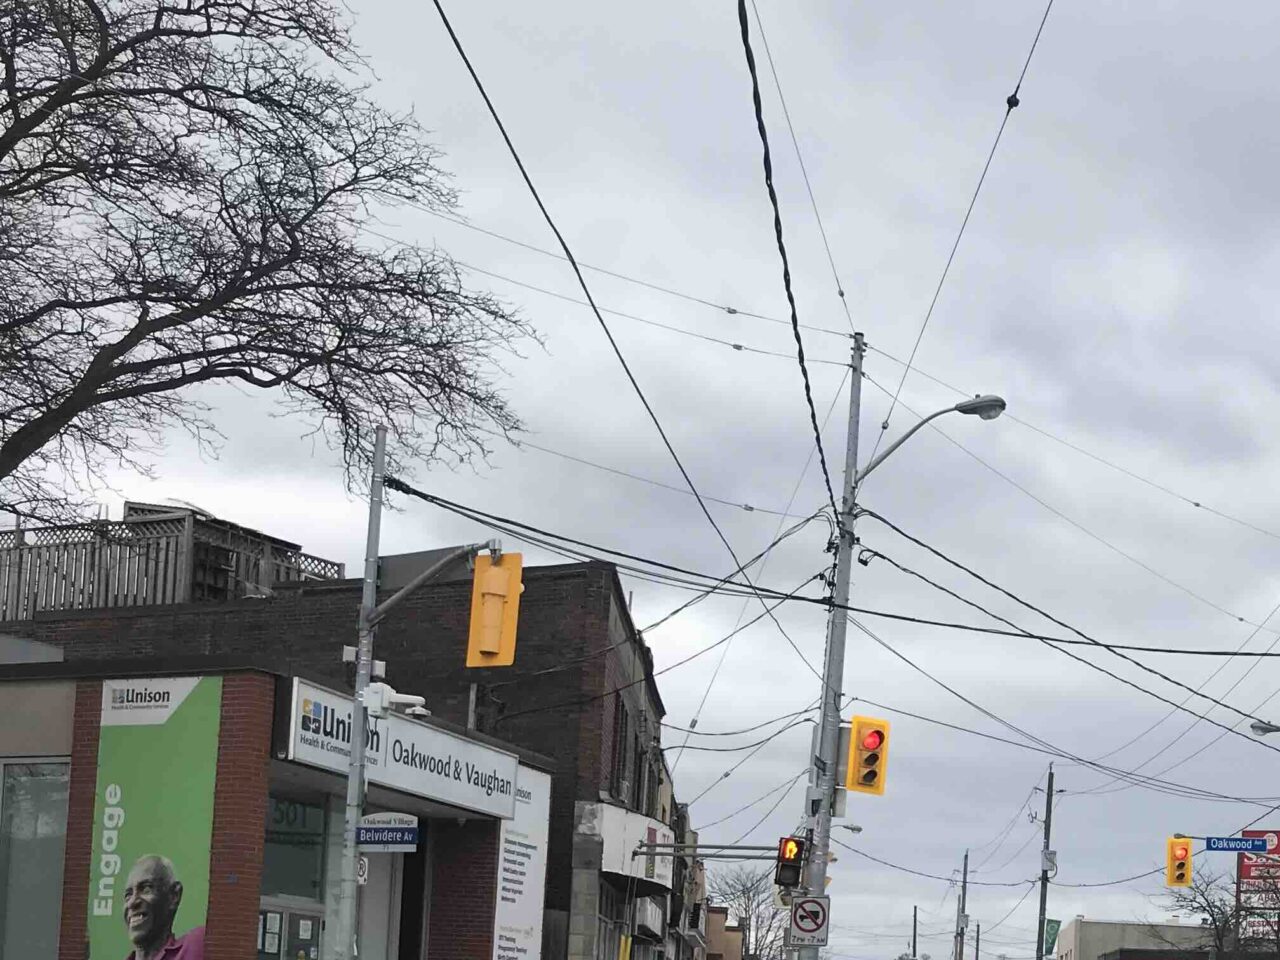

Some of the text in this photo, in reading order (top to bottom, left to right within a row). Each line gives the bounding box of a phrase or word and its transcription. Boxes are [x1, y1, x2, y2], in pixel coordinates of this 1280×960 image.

[126, 688, 170, 703] Unison
[300, 734, 319, 750] Health
[323, 705, 511, 796] Unin Oakwood & Vaughan
[515, 784, 532, 801] nison
[364, 817, 391, 825] Oakwood
[360, 831, 413, 842] Belvidere Av
[1211, 838, 1252, 849] Oakwood
[93, 784, 125, 916] Engage
